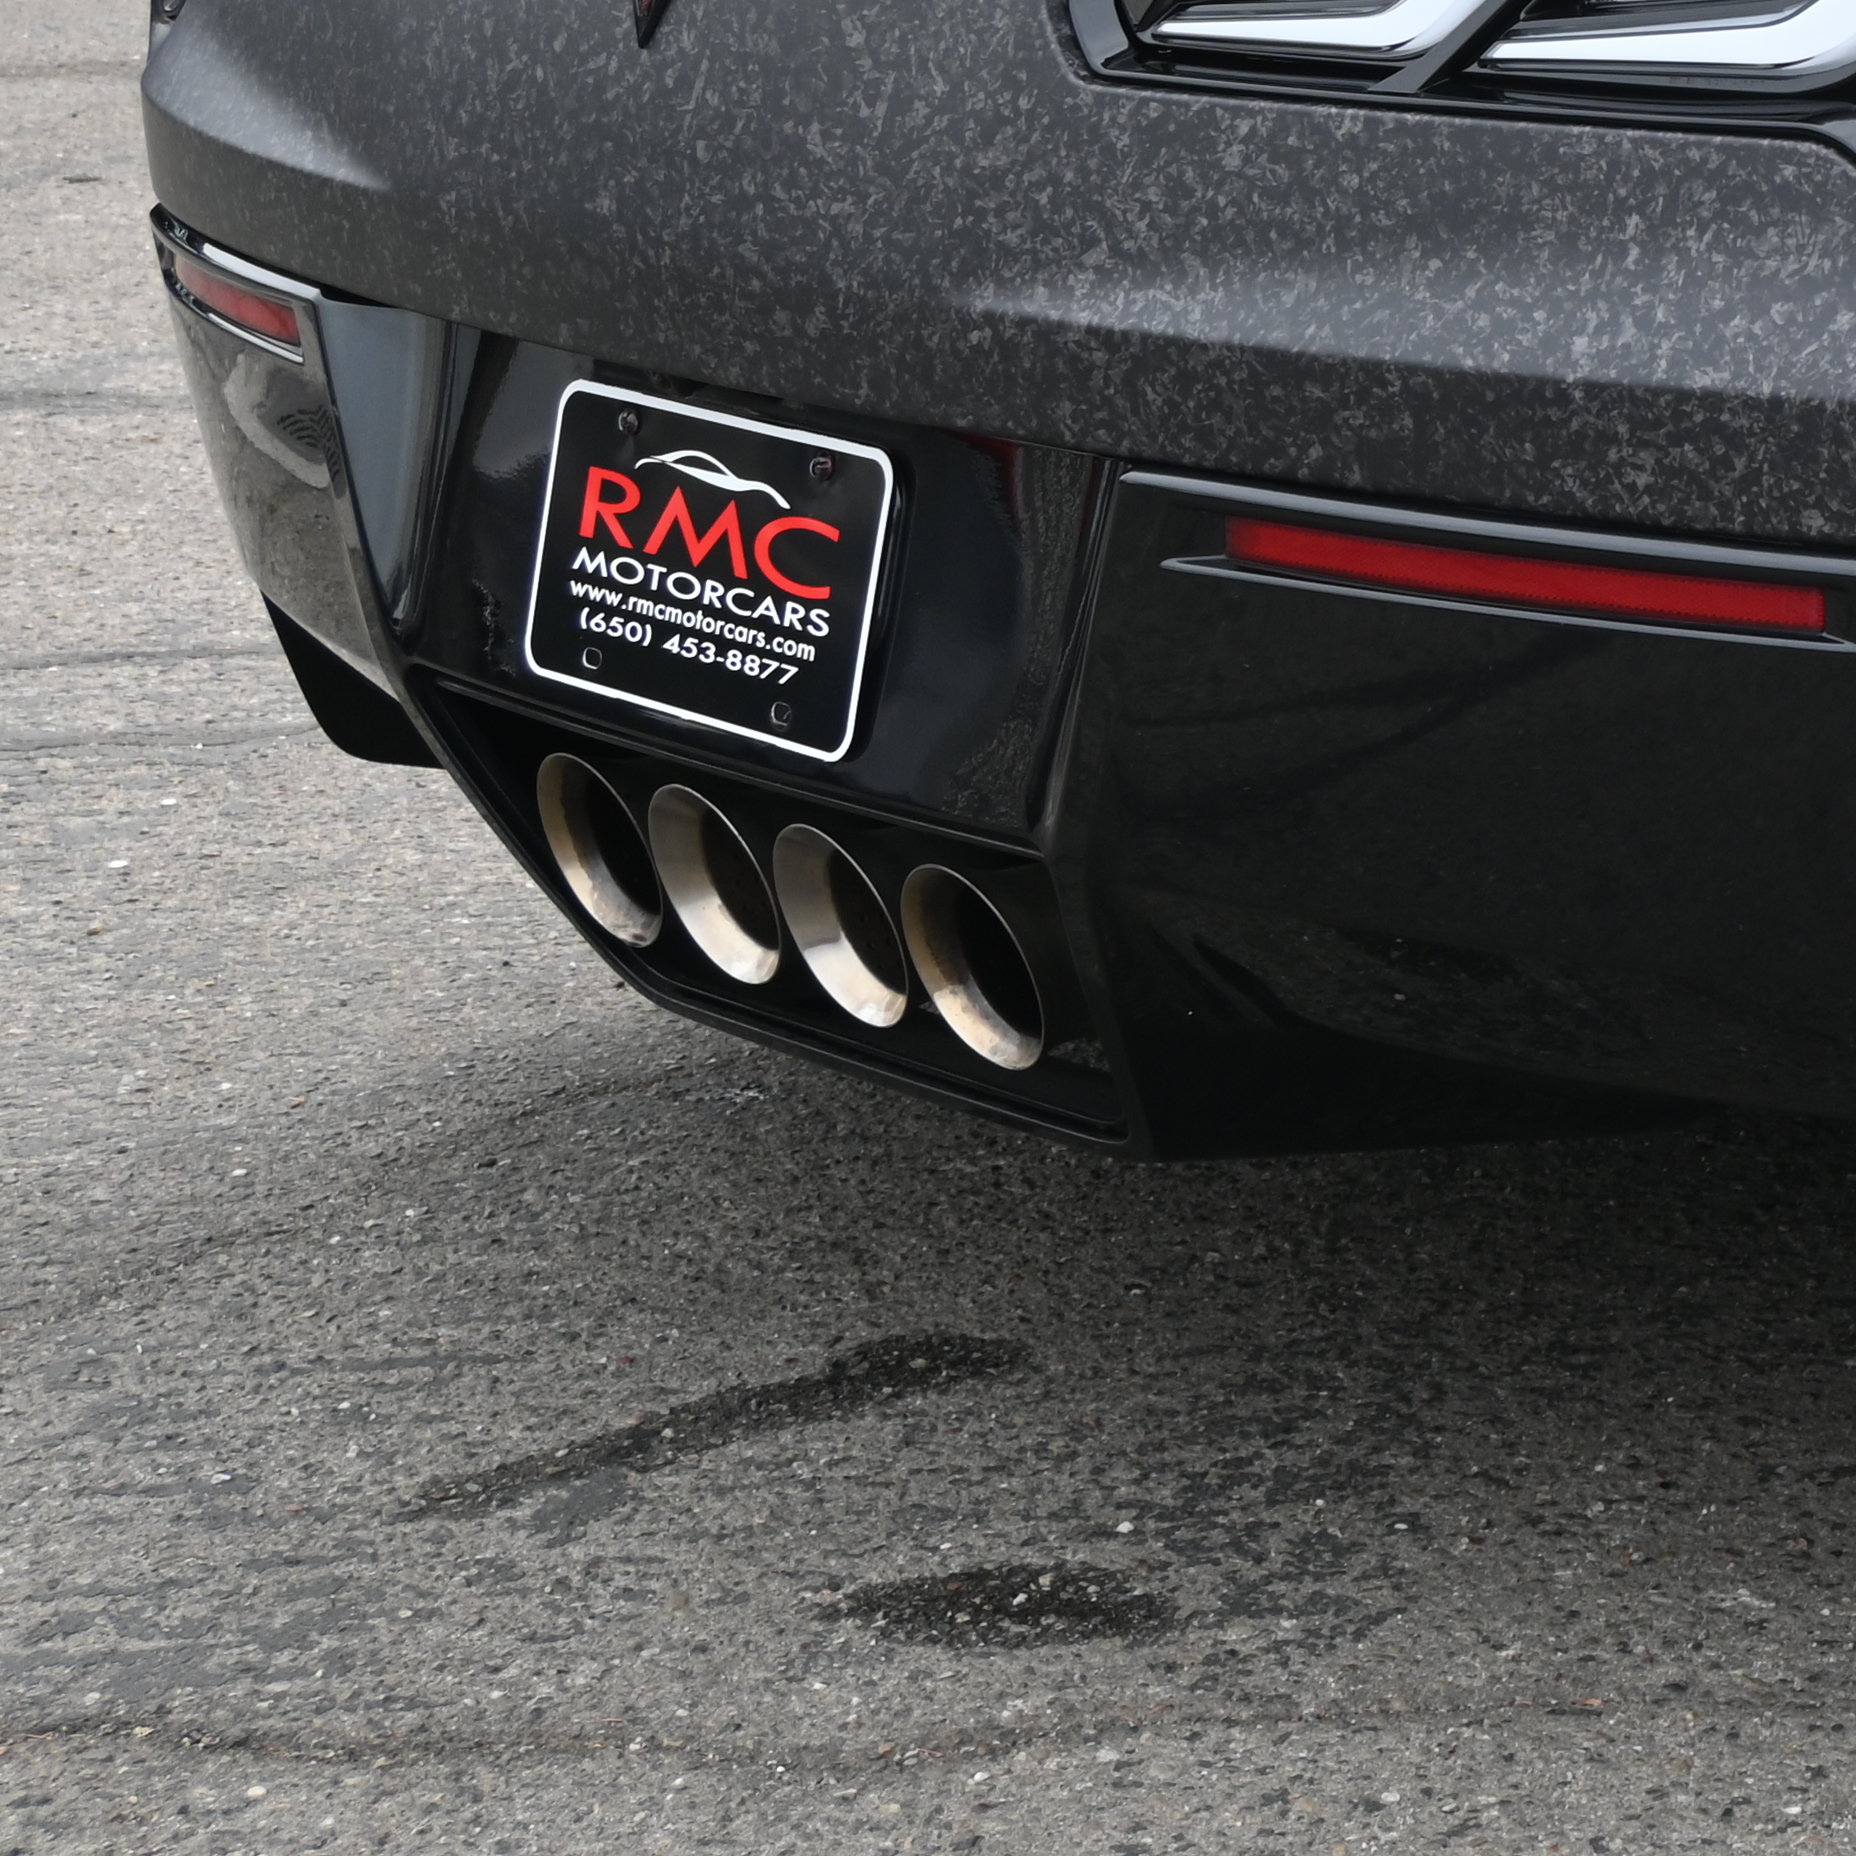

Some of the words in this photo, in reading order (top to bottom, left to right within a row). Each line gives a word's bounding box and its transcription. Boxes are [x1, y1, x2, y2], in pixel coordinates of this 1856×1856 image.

[579, 466, 840, 599] RMC
[569, 580, 816, 662] www.rmcmotorcars.com
[571, 546, 831, 639] MOTORCARS
[580, 608, 653, 649] (650)
[662, 634, 799, 685] 453-8877
